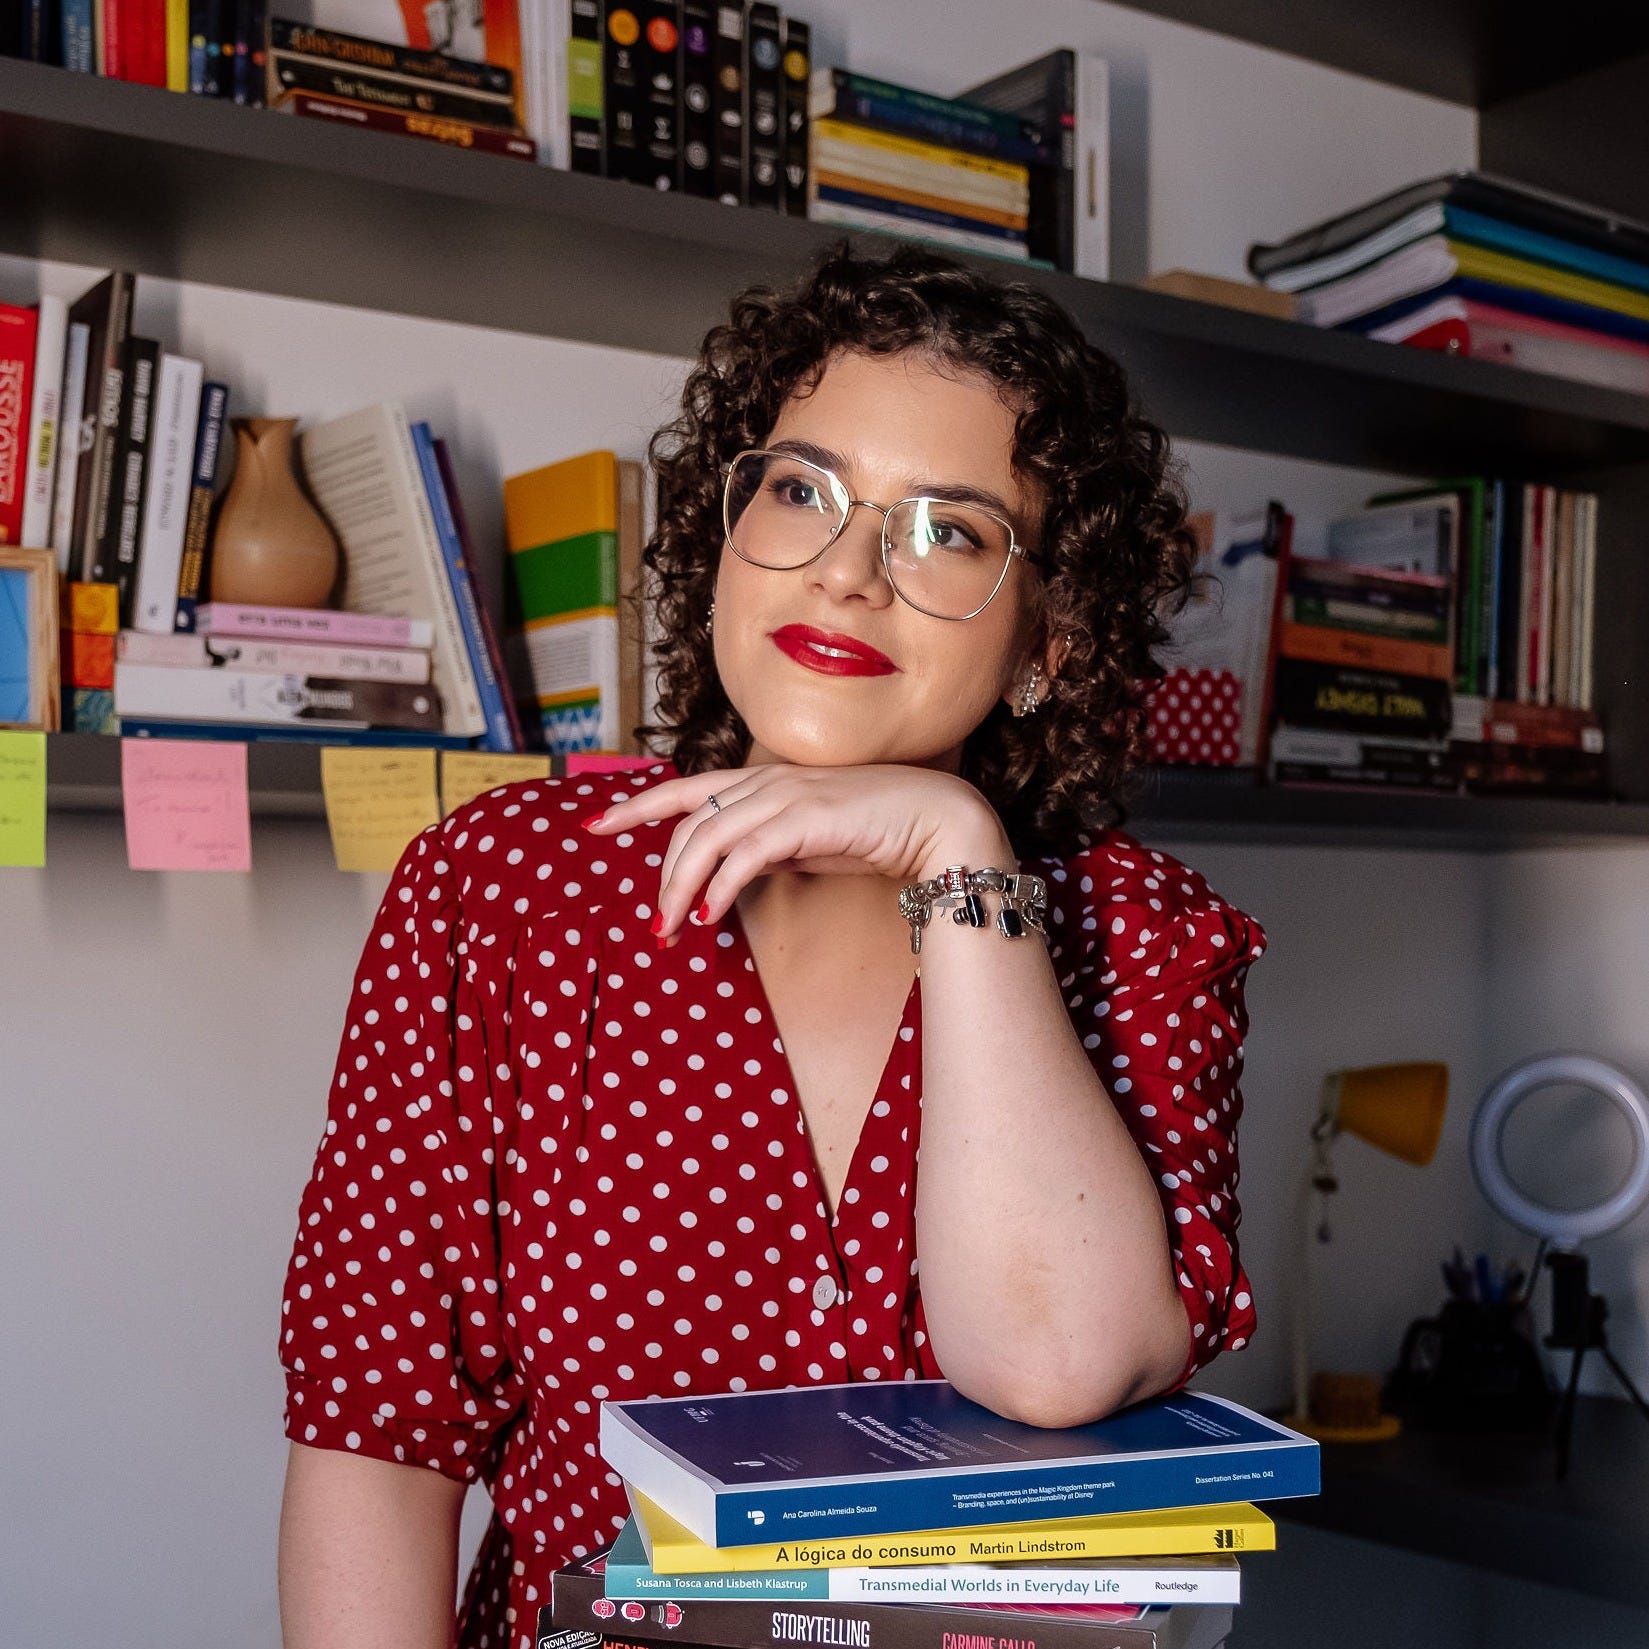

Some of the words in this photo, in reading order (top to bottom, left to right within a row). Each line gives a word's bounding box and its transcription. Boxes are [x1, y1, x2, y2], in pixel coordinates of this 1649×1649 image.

[1196, 1475, 1232, 1484] Dissertation
[1232, 1473, 1251, 1481] Series
[952, 1493, 986, 1501] Transmedia
[987, 1490, 1021, 1499] experiences
[1038, 1486, 1057, 1496] Magic
[1057, 1484, 1083, 1494] Kingdom
[1083, 1483, 1102, 1491] theme
[1102, 1480, 1116, 1490] park
[1074, 1491, 1094, 1500] Disney
[782, 1512, 796, 1520] Ana
[798, 1509, 826, 1519] Carolina
[826, 1507, 855, 1516] Almeida
[856, 1505, 878, 1514] Souza
[774, 1546, 790, 1563] A
[794, 1547, 846, 1566] lógica
[851, 1545, 873, 1560] do
[878, 1544, 957, 1559] consumo
[970, 1541, 1014, 1555] Martin
[1018, 1540, 1086, 1553] Lindstrom
[636, 1578, 672, 1590] Susana
[674, 1578, 702, 1589] Tosca
[704, 1578, 724, 1589] and
[726, 1578, 763, 1590] Lisbeth
[766, 1578, 808, 1592] Klastrup
[858, 1578, 947, 1592] Transmedial
[950, 1578, 1002, 1592] Worlds
[1006, 1579, 1020, 1592] in
[1024, 1578, 1090, 1596] Everyday
[1094, 1579, 1120, 1593] Life
[1155, 1581, 1199, 1592] Routledge
[772, 1612, 870, 1648] STORYTELLING
[543, 1637, 566, 1649] NOVA
